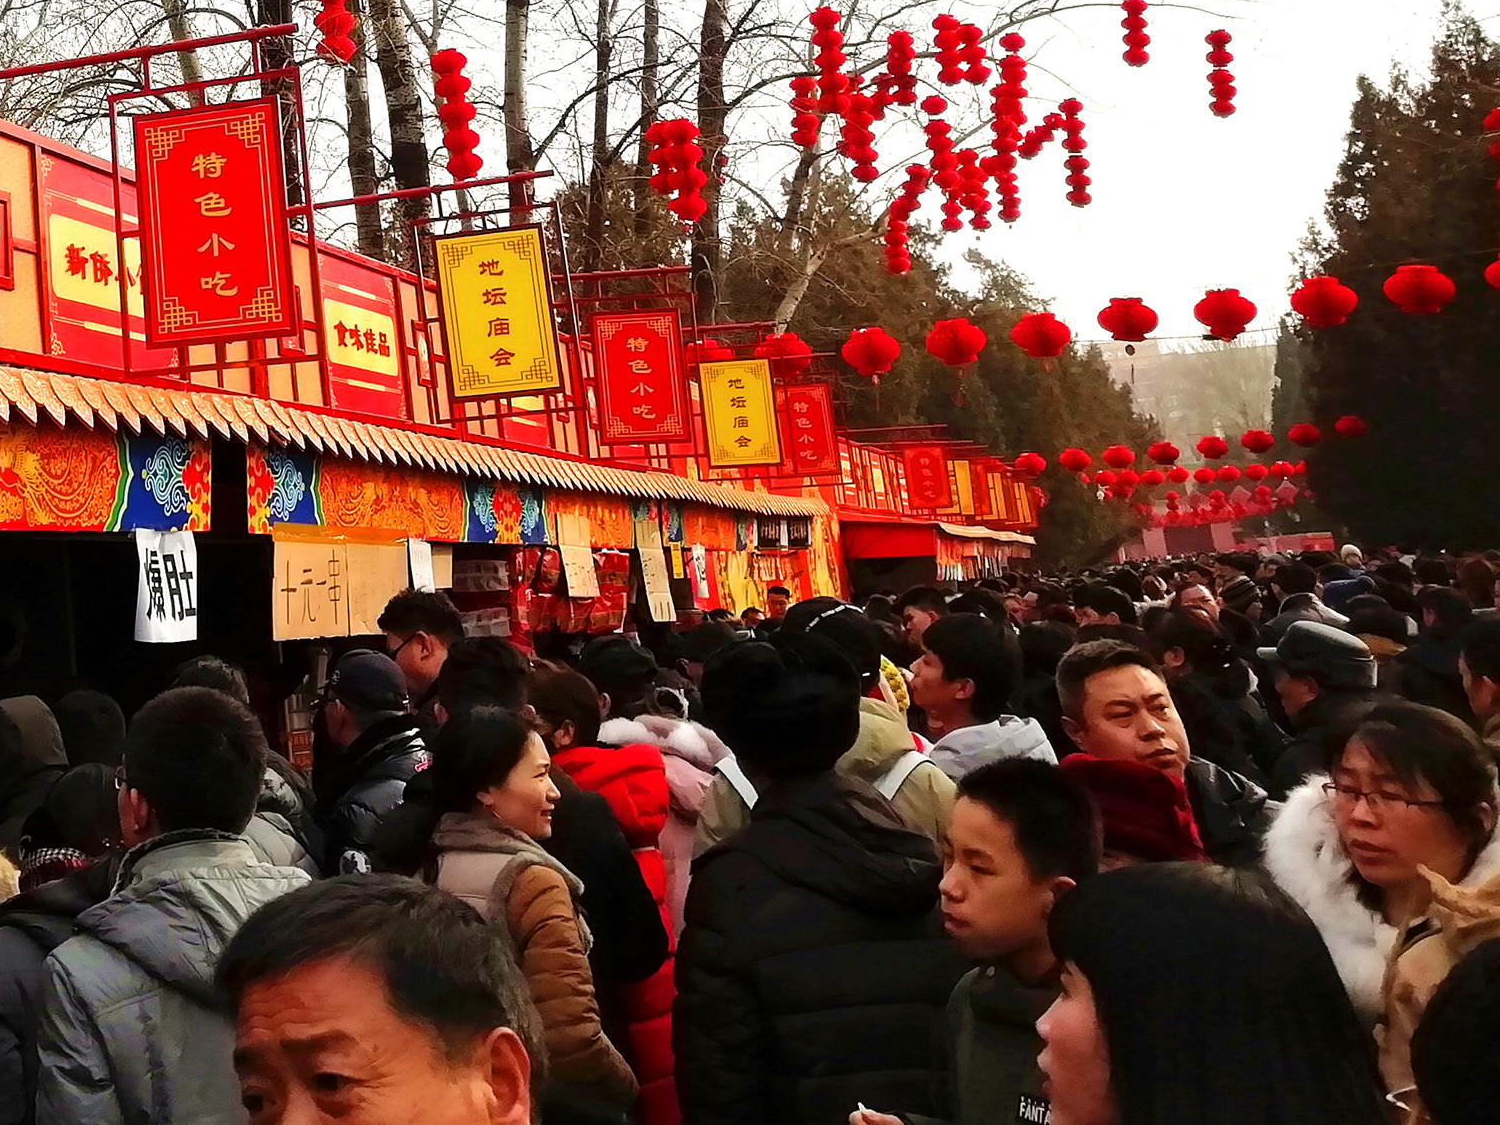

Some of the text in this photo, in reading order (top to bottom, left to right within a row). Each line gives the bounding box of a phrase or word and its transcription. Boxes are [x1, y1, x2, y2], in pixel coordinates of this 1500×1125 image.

[190, 151, 238, 297] 特色小吃
[333, 320, 391, 358] 食味佳品
[478, 259, 516, 367] 地坛庙会
[626, 336, 656, 419] 特色小吃
[727, 378, 752, 448] 地坛庙会
[793, 401, 818, 461] 特色小吃
[280, 548, 342, 625] 十元一串
